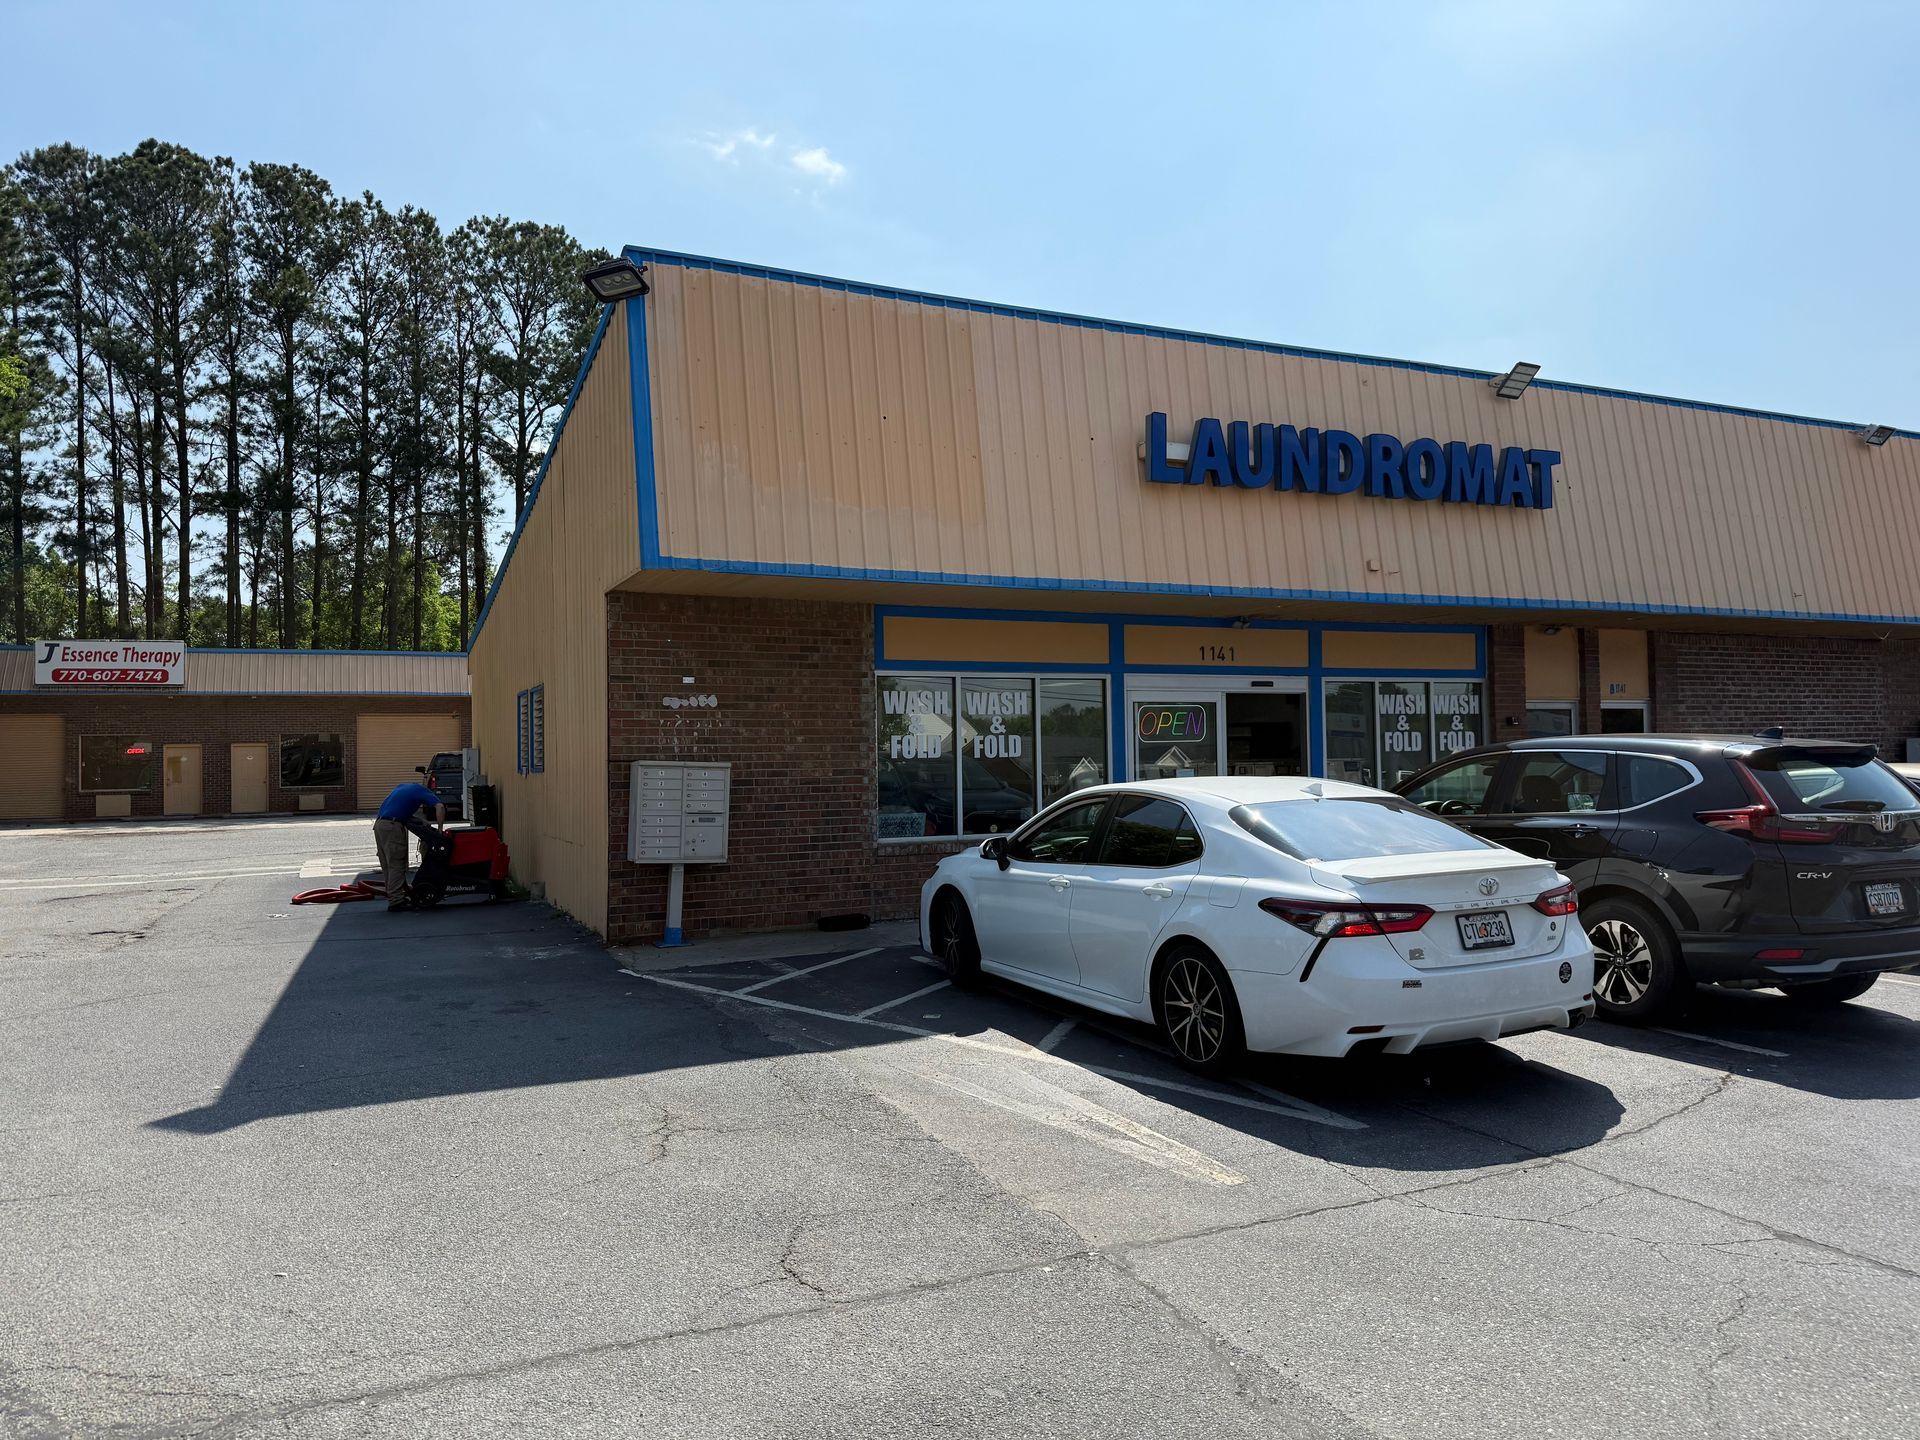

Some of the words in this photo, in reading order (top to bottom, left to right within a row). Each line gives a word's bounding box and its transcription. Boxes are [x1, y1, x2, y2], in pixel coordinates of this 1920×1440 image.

[1145, 412, 1561, 509] LAUNDROMAT
[38, 643, 60, 664] J
[61, 647, 118, 662] Essence
[122, 647, 181, 667] Therapy
[1199, 646, 1235, 661] 1141
[59, 670, 162, 681] 770-607-7474
[883, 690, 950, 715] WASH
[966, 692, 1028, 715] WASH
[1378, 694, 1426, 714] WASH
[1433, 694, 1480, 714] WASH
[908, 715, 924, 734] &
[989, 715, 1007, 734] &
[1140, 711, 1204, 736] OPEN
[1396, 715, 1410, 731] &
[1451, 715, 1464, 730] &
[890, 735, 942, 759] FOLD
[973, 735, 1022, 758] FOLD
[1385, 731, 1422, 752] FOLD
[1439, 731, 1475, 752] FOLD
[1868, 892, 1900, 907] CSB7079
